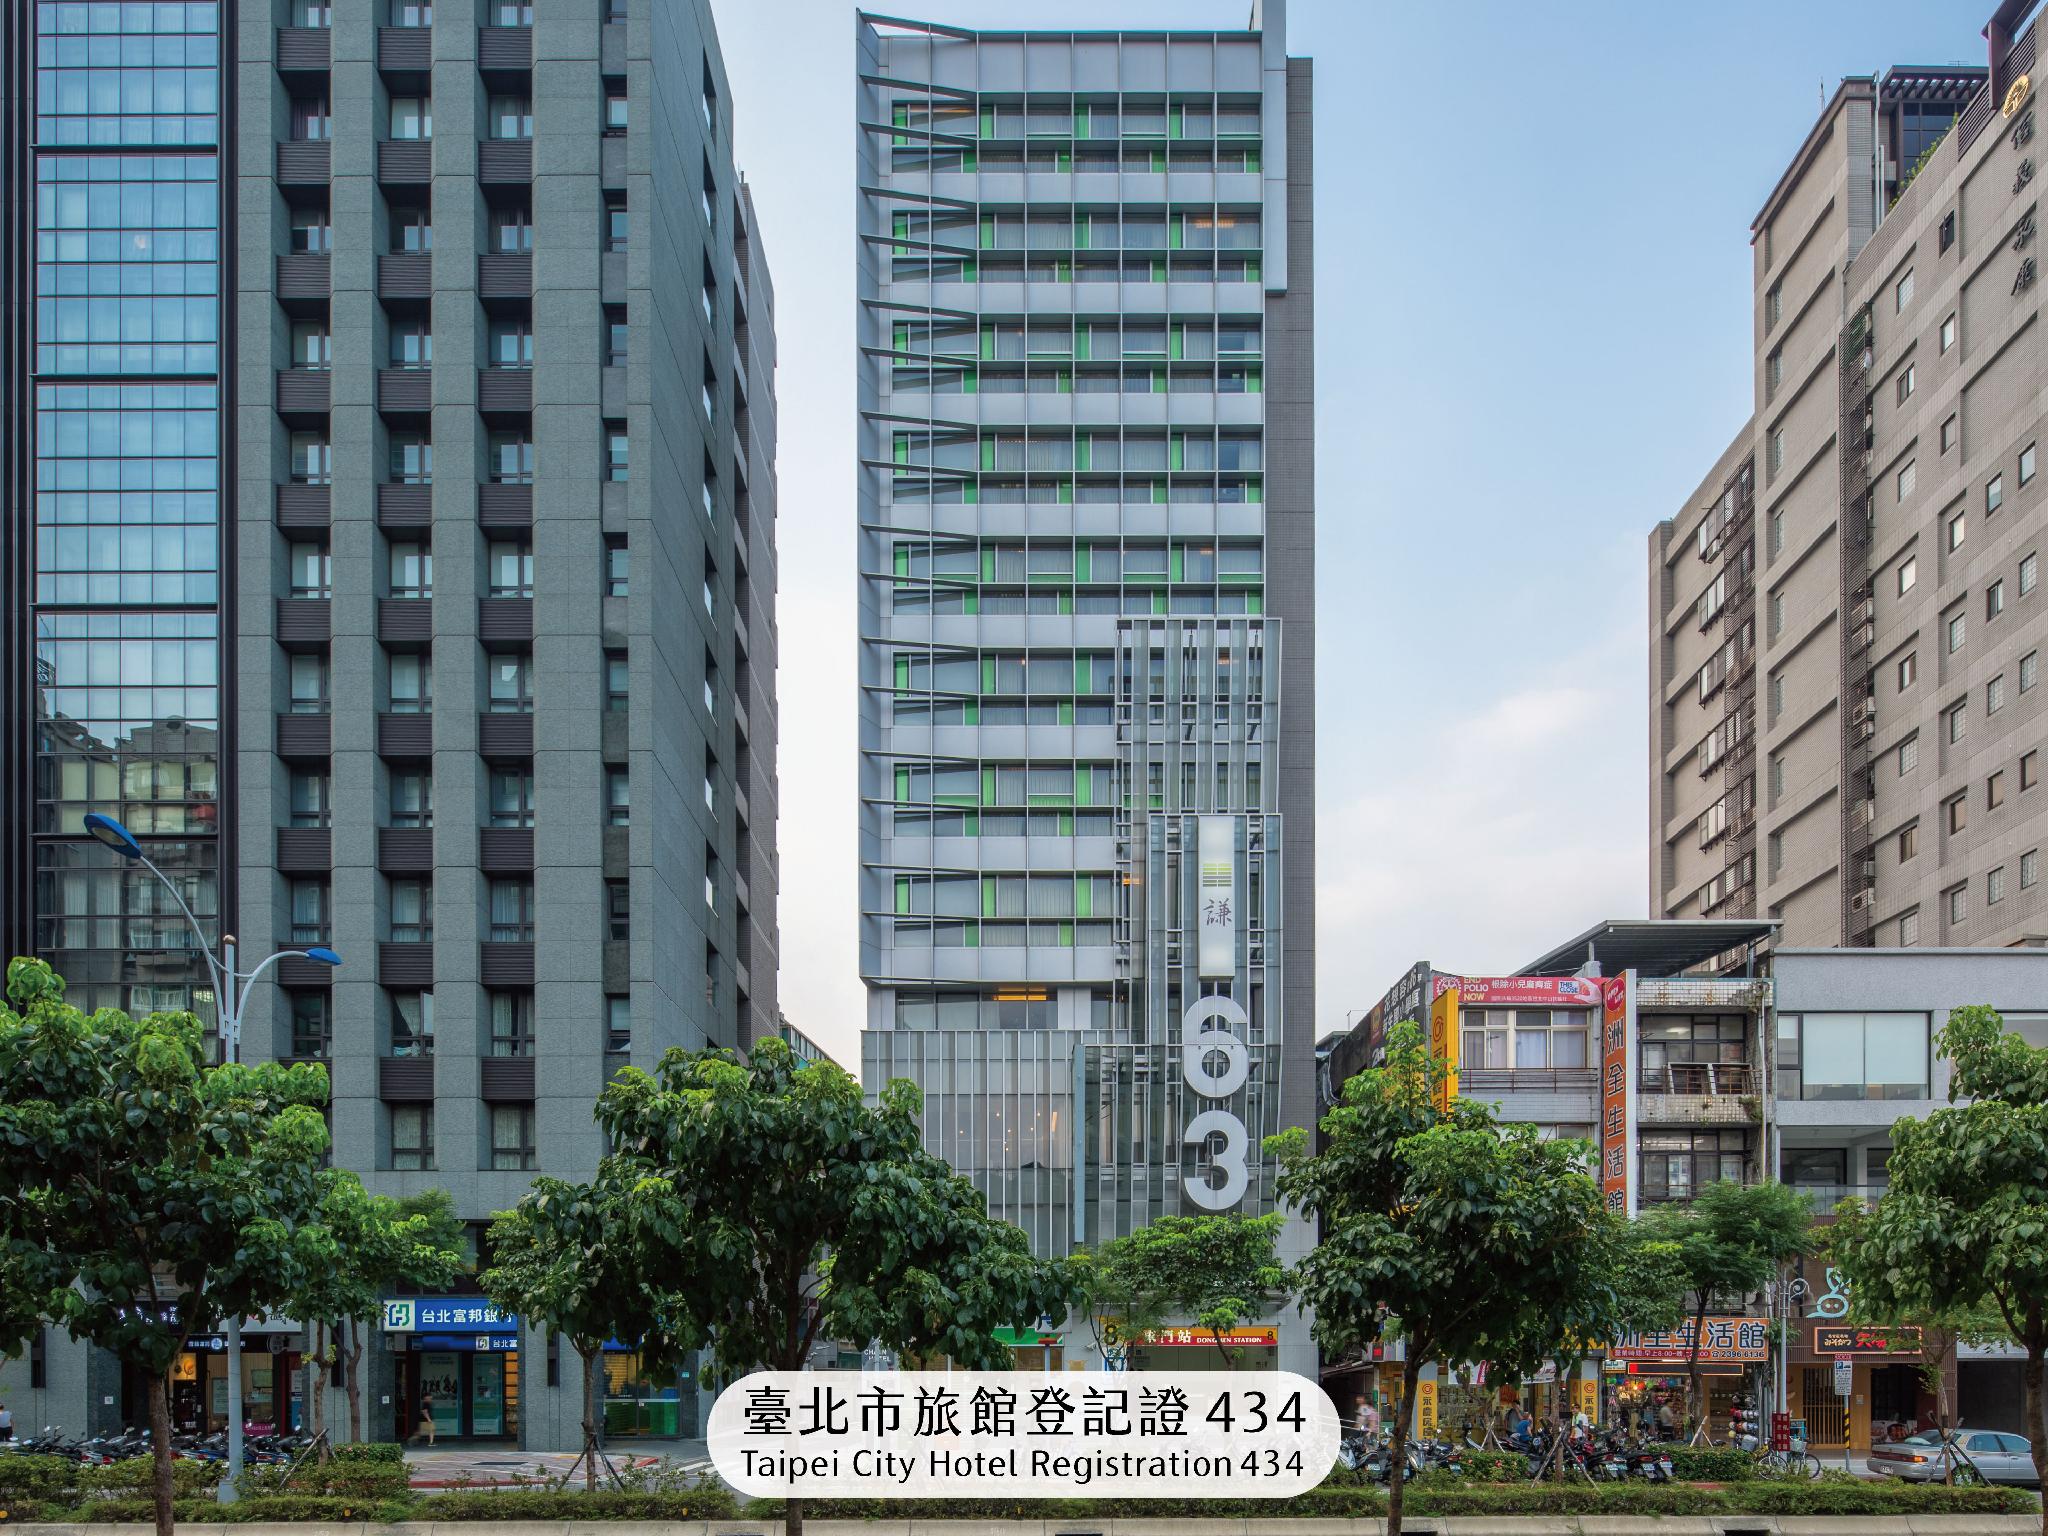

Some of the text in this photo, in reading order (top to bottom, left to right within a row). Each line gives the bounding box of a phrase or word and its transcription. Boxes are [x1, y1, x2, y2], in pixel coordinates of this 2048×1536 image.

[1203, 897, 1232, 927] 謙
[1463, 993, 1484, 1001] NOW
[1607, 1017, 1624, 1216] 洲全生活館
[1267, 1330, 1274, 1340] 8
[1721, 1350, 1742, 1358] 2396
